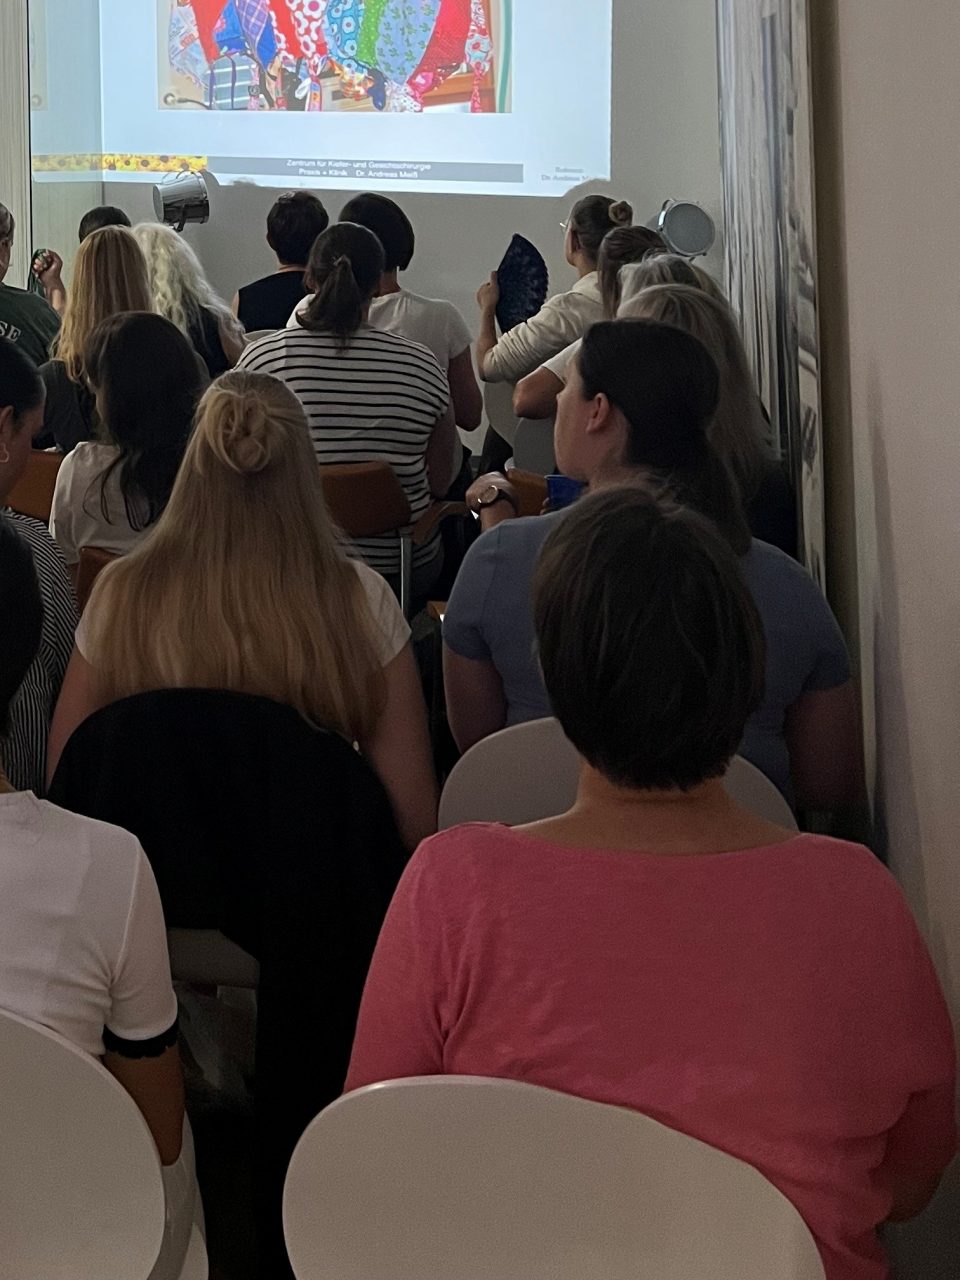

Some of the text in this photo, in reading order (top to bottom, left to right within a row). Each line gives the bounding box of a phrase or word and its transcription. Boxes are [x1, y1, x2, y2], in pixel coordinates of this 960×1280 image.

[286, 159, 316, 167] Zentrum
[328, 169, 348, 177] Klinik
[367, 170, 398, 178] Andreas
